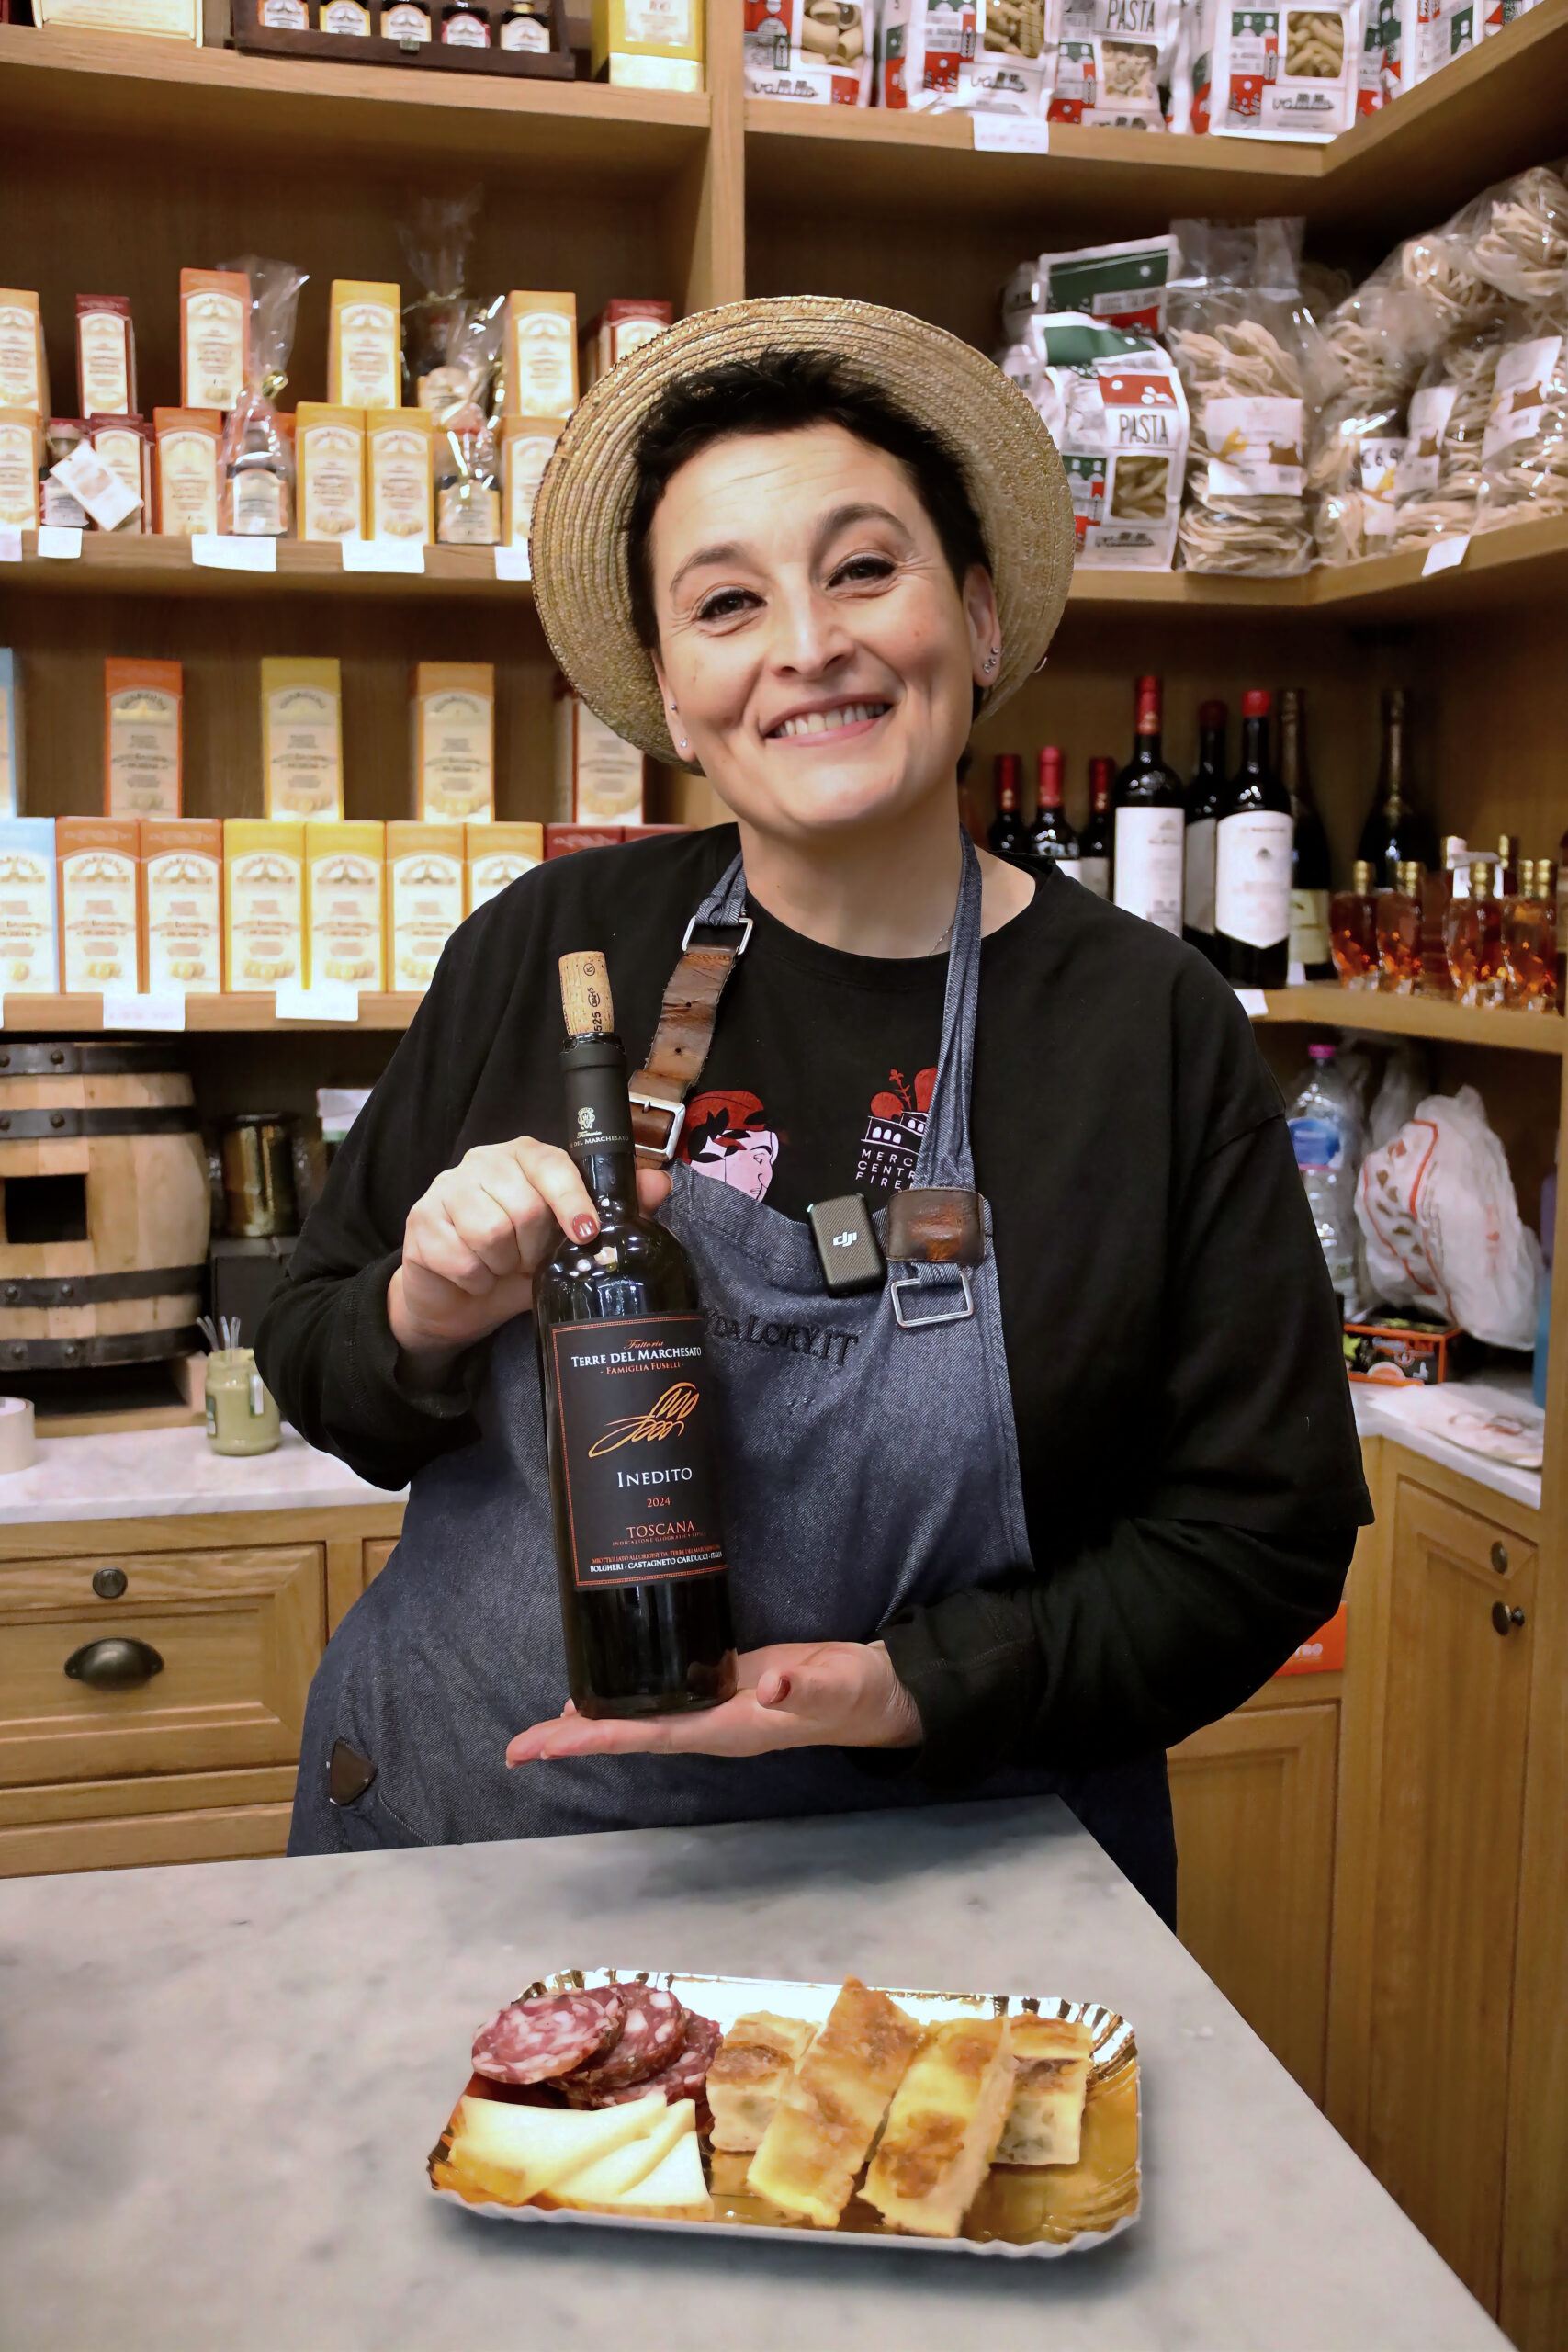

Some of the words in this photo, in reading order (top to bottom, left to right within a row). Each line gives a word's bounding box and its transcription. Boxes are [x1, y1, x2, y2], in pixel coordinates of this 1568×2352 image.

[1106, 0, 1156, 33] PASTA
[1119, 413, 1169, 445] PASTA
[861, 1148, 914, 1167] MERC
[857, 1160, 917, 1180] CENTR
[855, 1171, 916, 1190] FIRE
[623, 1339, 664, 1351] Fattoria
[570, 1354, 607, 1368] TERRE
[610, 1351, 636, 1364] DEL
[637, 1346, 702, 1361] MARCHESATO
[606, 1363, 649, 1375] FAMIGLIA
[650, 1361, 681, 1371] FUSELLI
[616, 1467, 693, 1487] INEDITO
[647, 1497, 671, 1508] 2024
[626, 1521, 695, 1539] TOSCANA
[590, 1564, 625, 1573] BOLGHERI
[627, 1558, 677, 1570] CASTAGNETO
[676, 1552, 709, 1565] CARDUCCI
